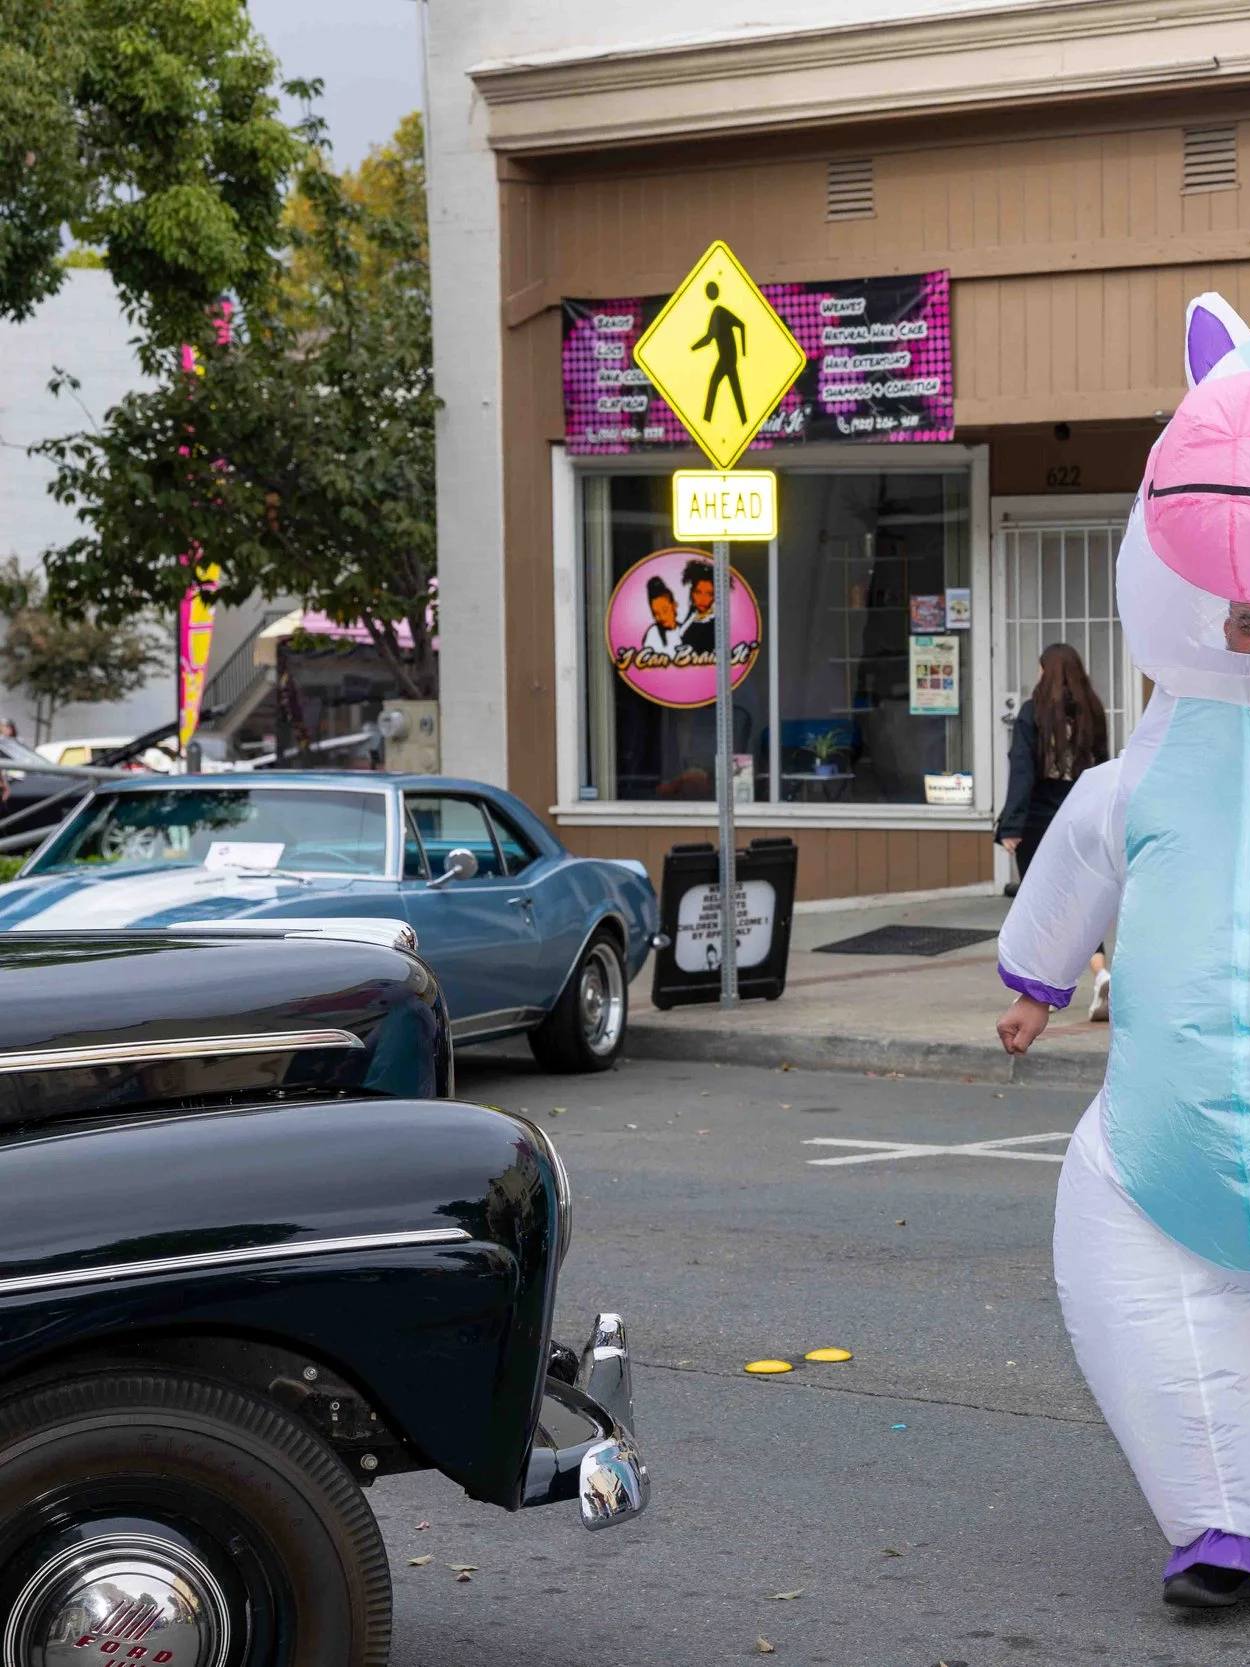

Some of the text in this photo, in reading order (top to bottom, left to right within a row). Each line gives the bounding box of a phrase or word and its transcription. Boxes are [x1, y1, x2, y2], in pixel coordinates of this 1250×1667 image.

[821, 301, 863, 314] WEAVES
[823, 323, 927, 342] NATURAL HAIR CARE
[824, 354, 910, 371] HAIR EXTENSIONS
[823, 386, 872, 399] SHAMPOO
[885, 382, 939, 395] CONDITION
[1046, 466, 1082, 487] 622
[689, 492, 763, 519] AHEAD
[635, 647, 669, 669] Can
[73, 1635, 174, 1664] FORD
